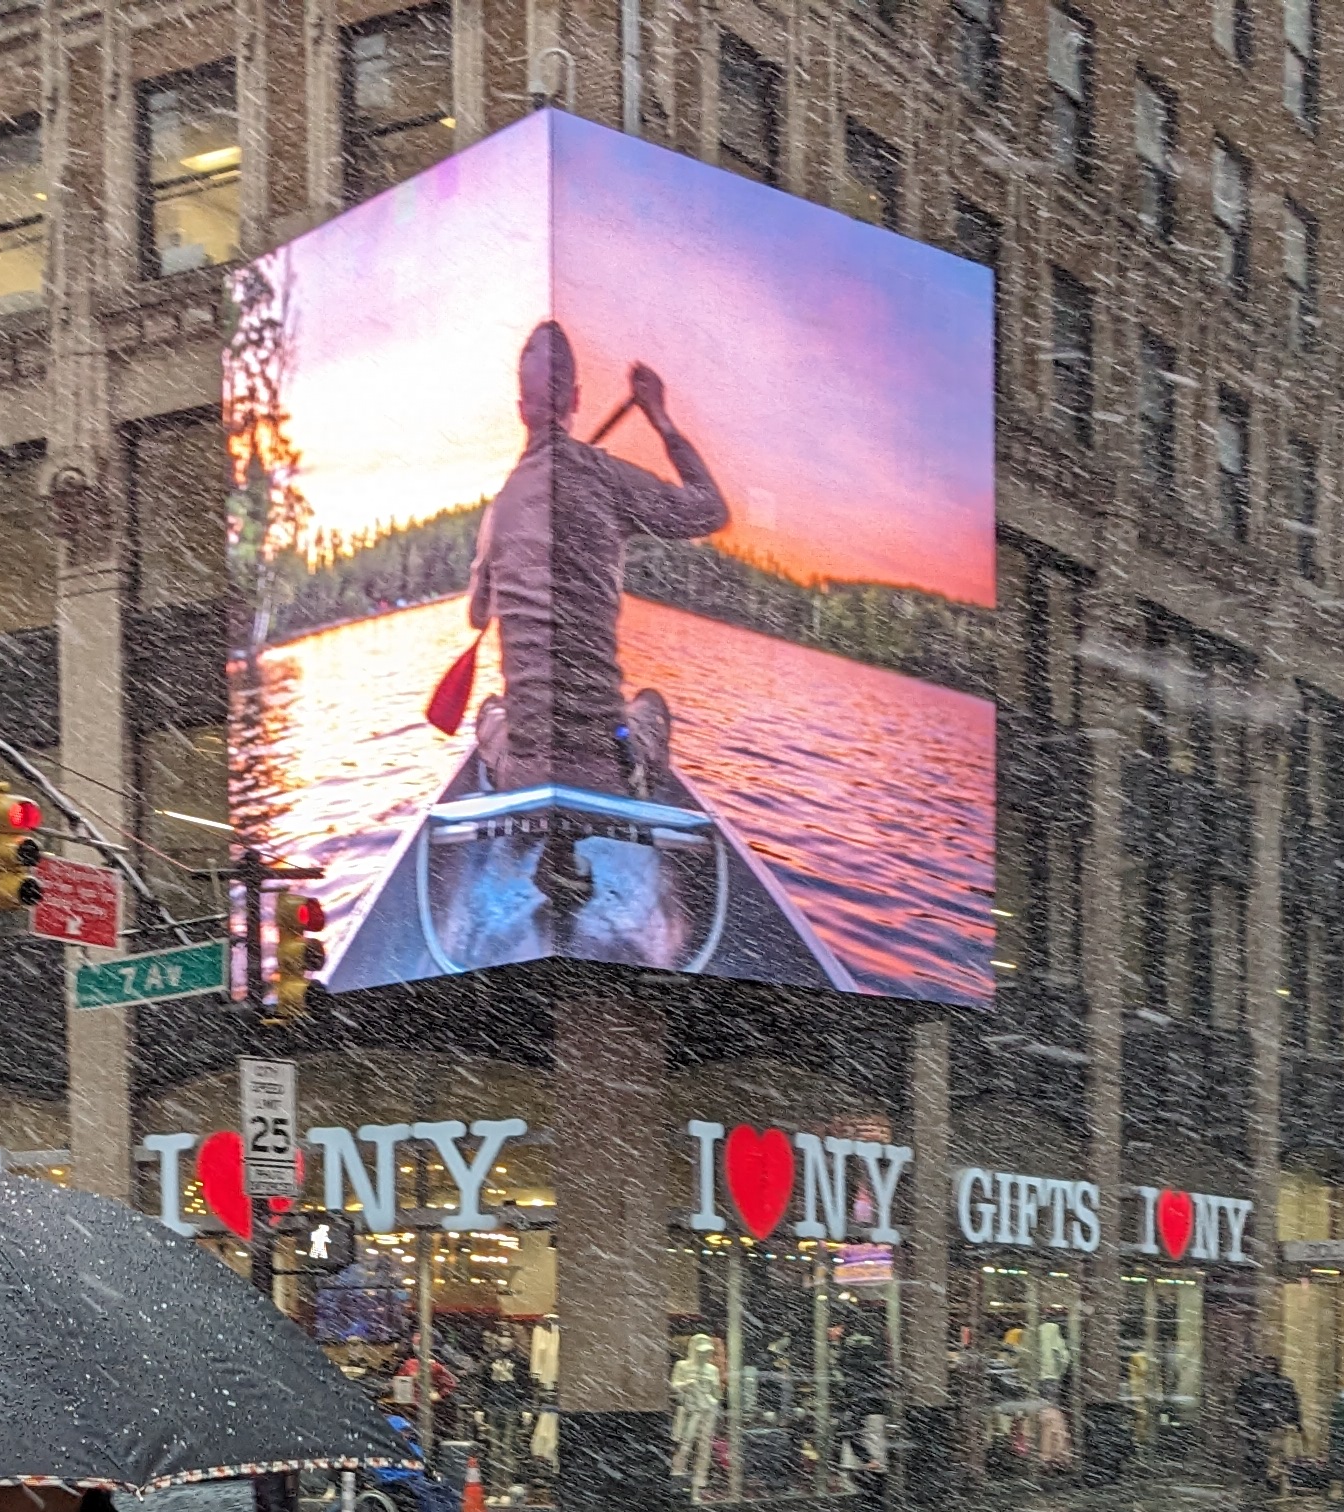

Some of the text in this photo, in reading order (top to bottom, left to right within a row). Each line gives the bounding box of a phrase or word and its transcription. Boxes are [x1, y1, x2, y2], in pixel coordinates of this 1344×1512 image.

[118, 967, 137, 994] 7
[250, 1115, 291, 1154] 25
[142, 1118, 528, 1238] I NY
[688, 1119, 913, 1246] I NY
[957, 1167, 1100, 1253] GIFTS
[1139, 1186, 1254, 1262] I NY
